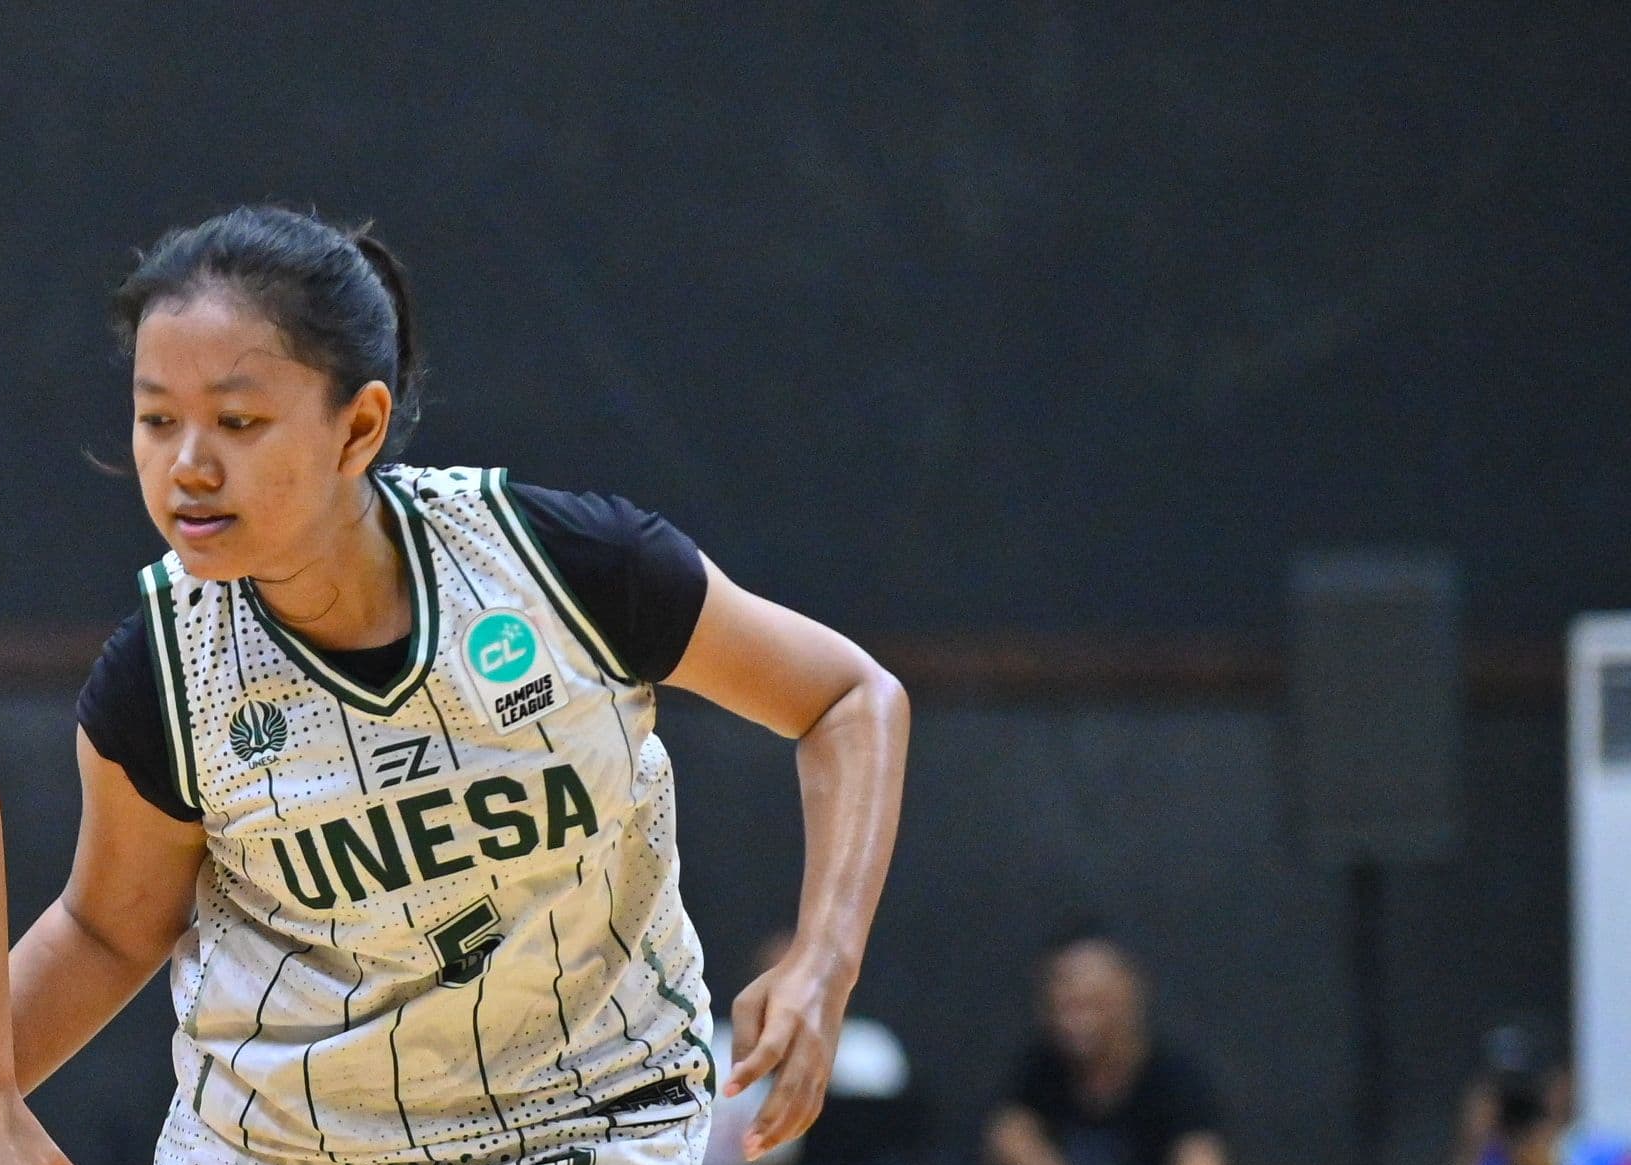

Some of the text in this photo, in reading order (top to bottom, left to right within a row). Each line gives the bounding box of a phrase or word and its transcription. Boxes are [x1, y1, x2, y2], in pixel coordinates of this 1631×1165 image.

[495, 673, 552, 713] CAMPUS
[502, 689, 555, 727] LEAGUE
[272, 764, 599, 910] UNESA
[425, 895, 506, 989] 5
